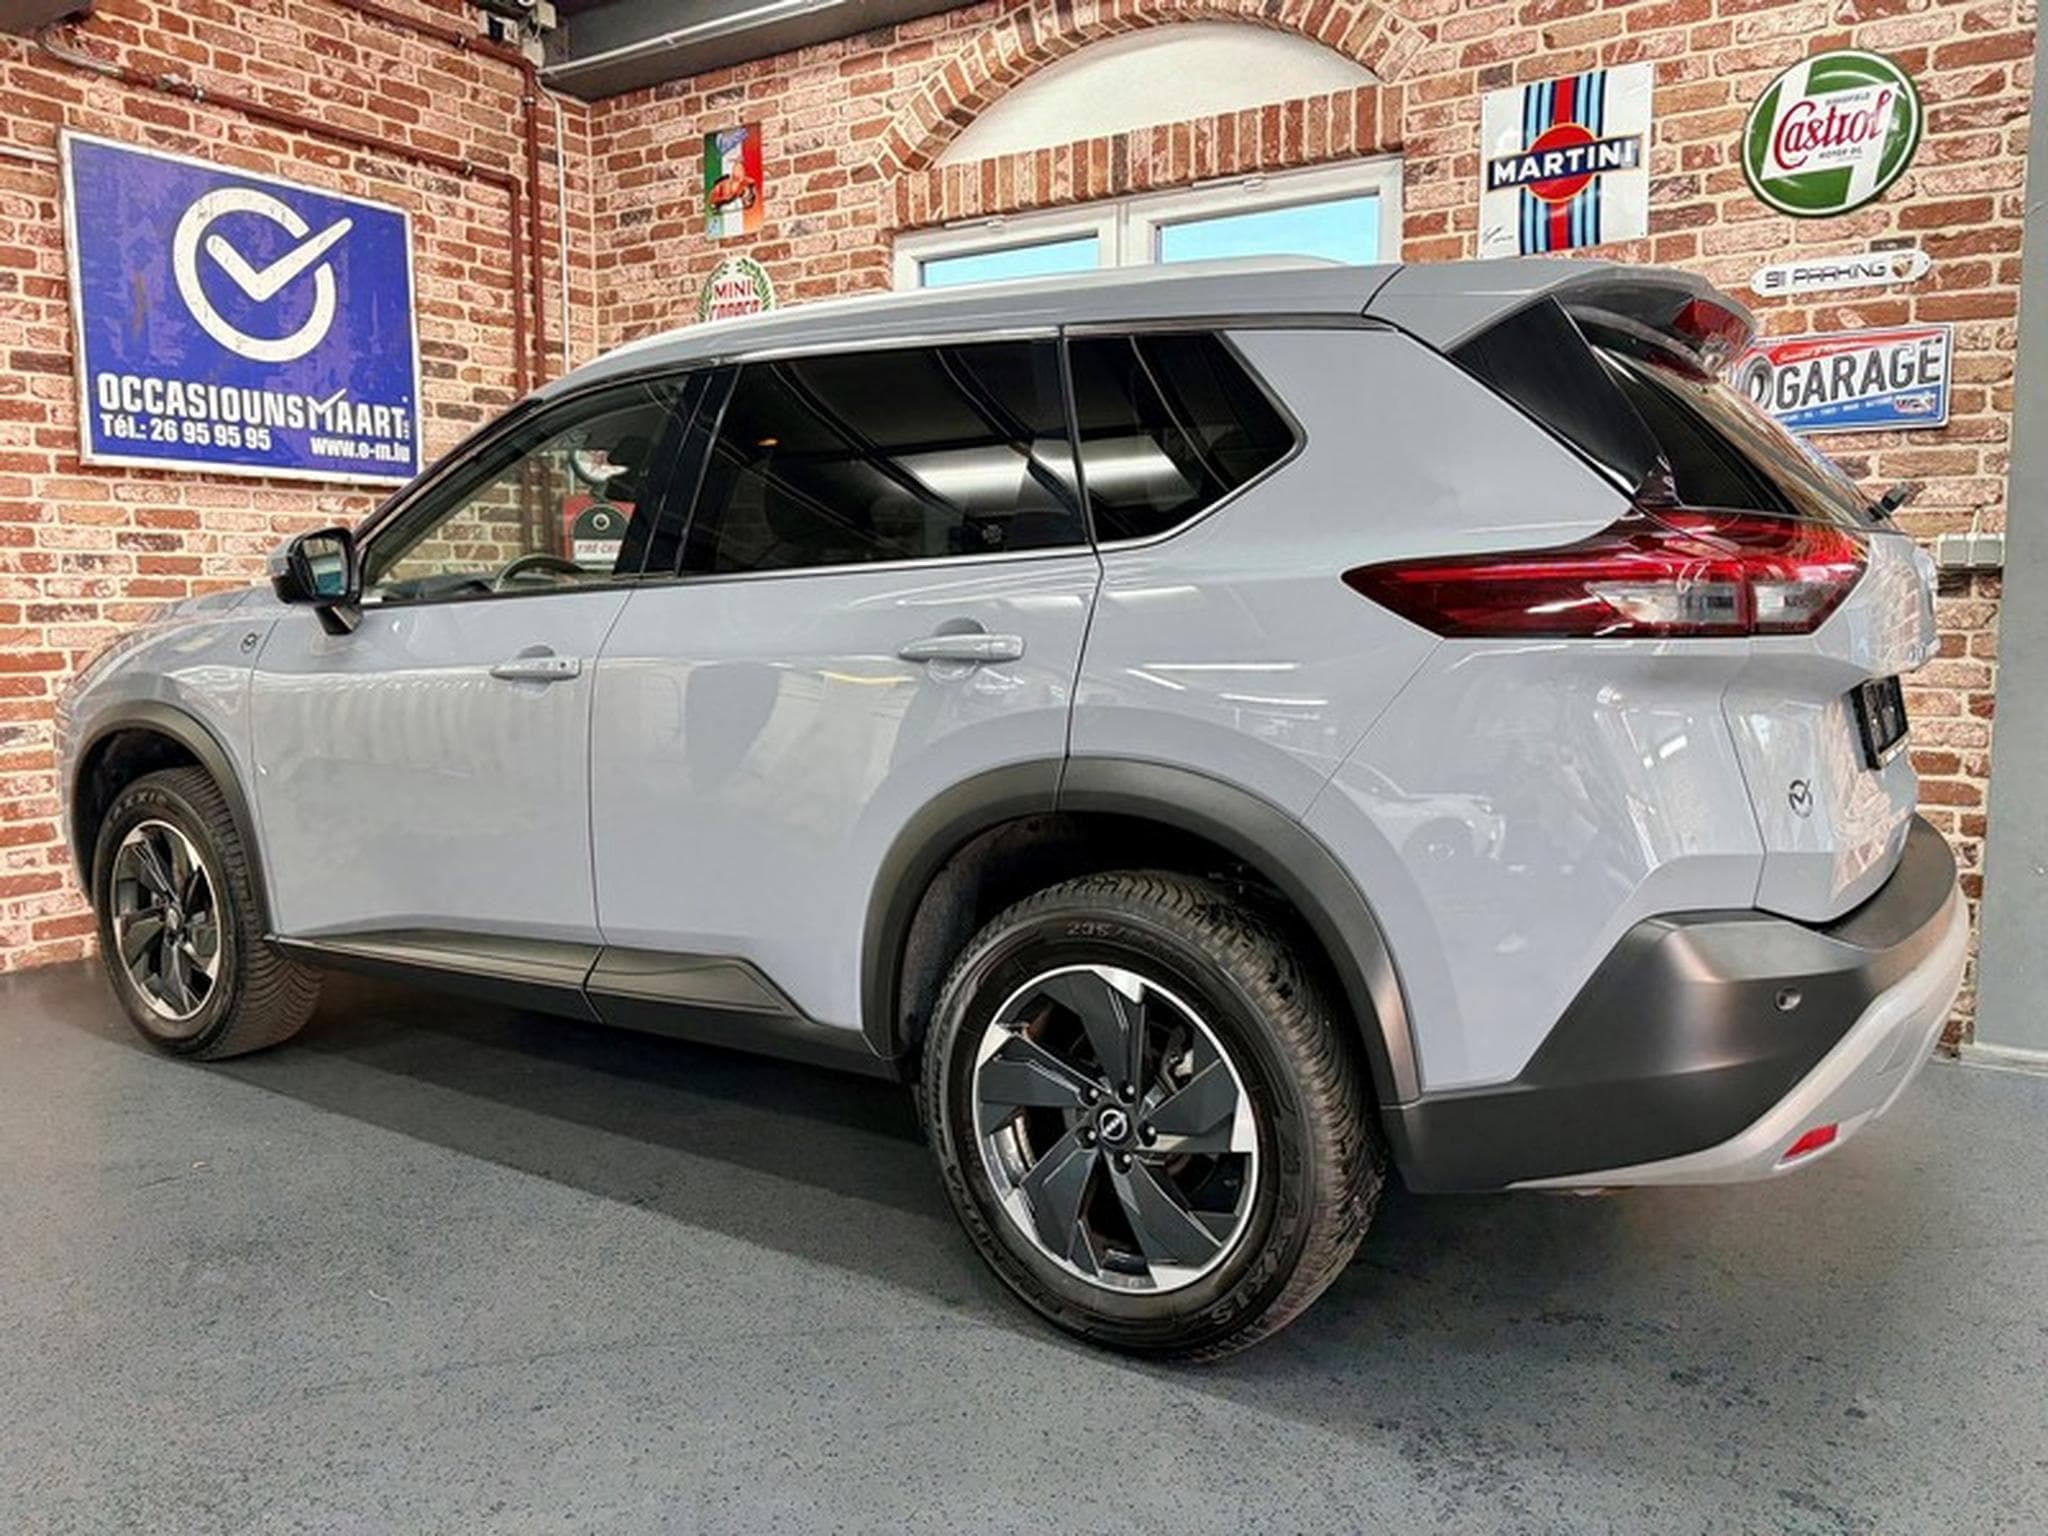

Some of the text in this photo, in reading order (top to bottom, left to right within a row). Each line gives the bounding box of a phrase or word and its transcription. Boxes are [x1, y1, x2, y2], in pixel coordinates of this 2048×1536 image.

[1773, 89, 1893, 170] Castrol
[1492, 141, 1634, 186] MARTINI
[714, 280, 751, 300] MINI
[1792, 261, 1887, 285] PARKING
[150, 417, 179, 443] 26
[182, 420, 211, 446] 95
[214, 424, 242, 448] 95
[245, 427, 272, 451] 95
